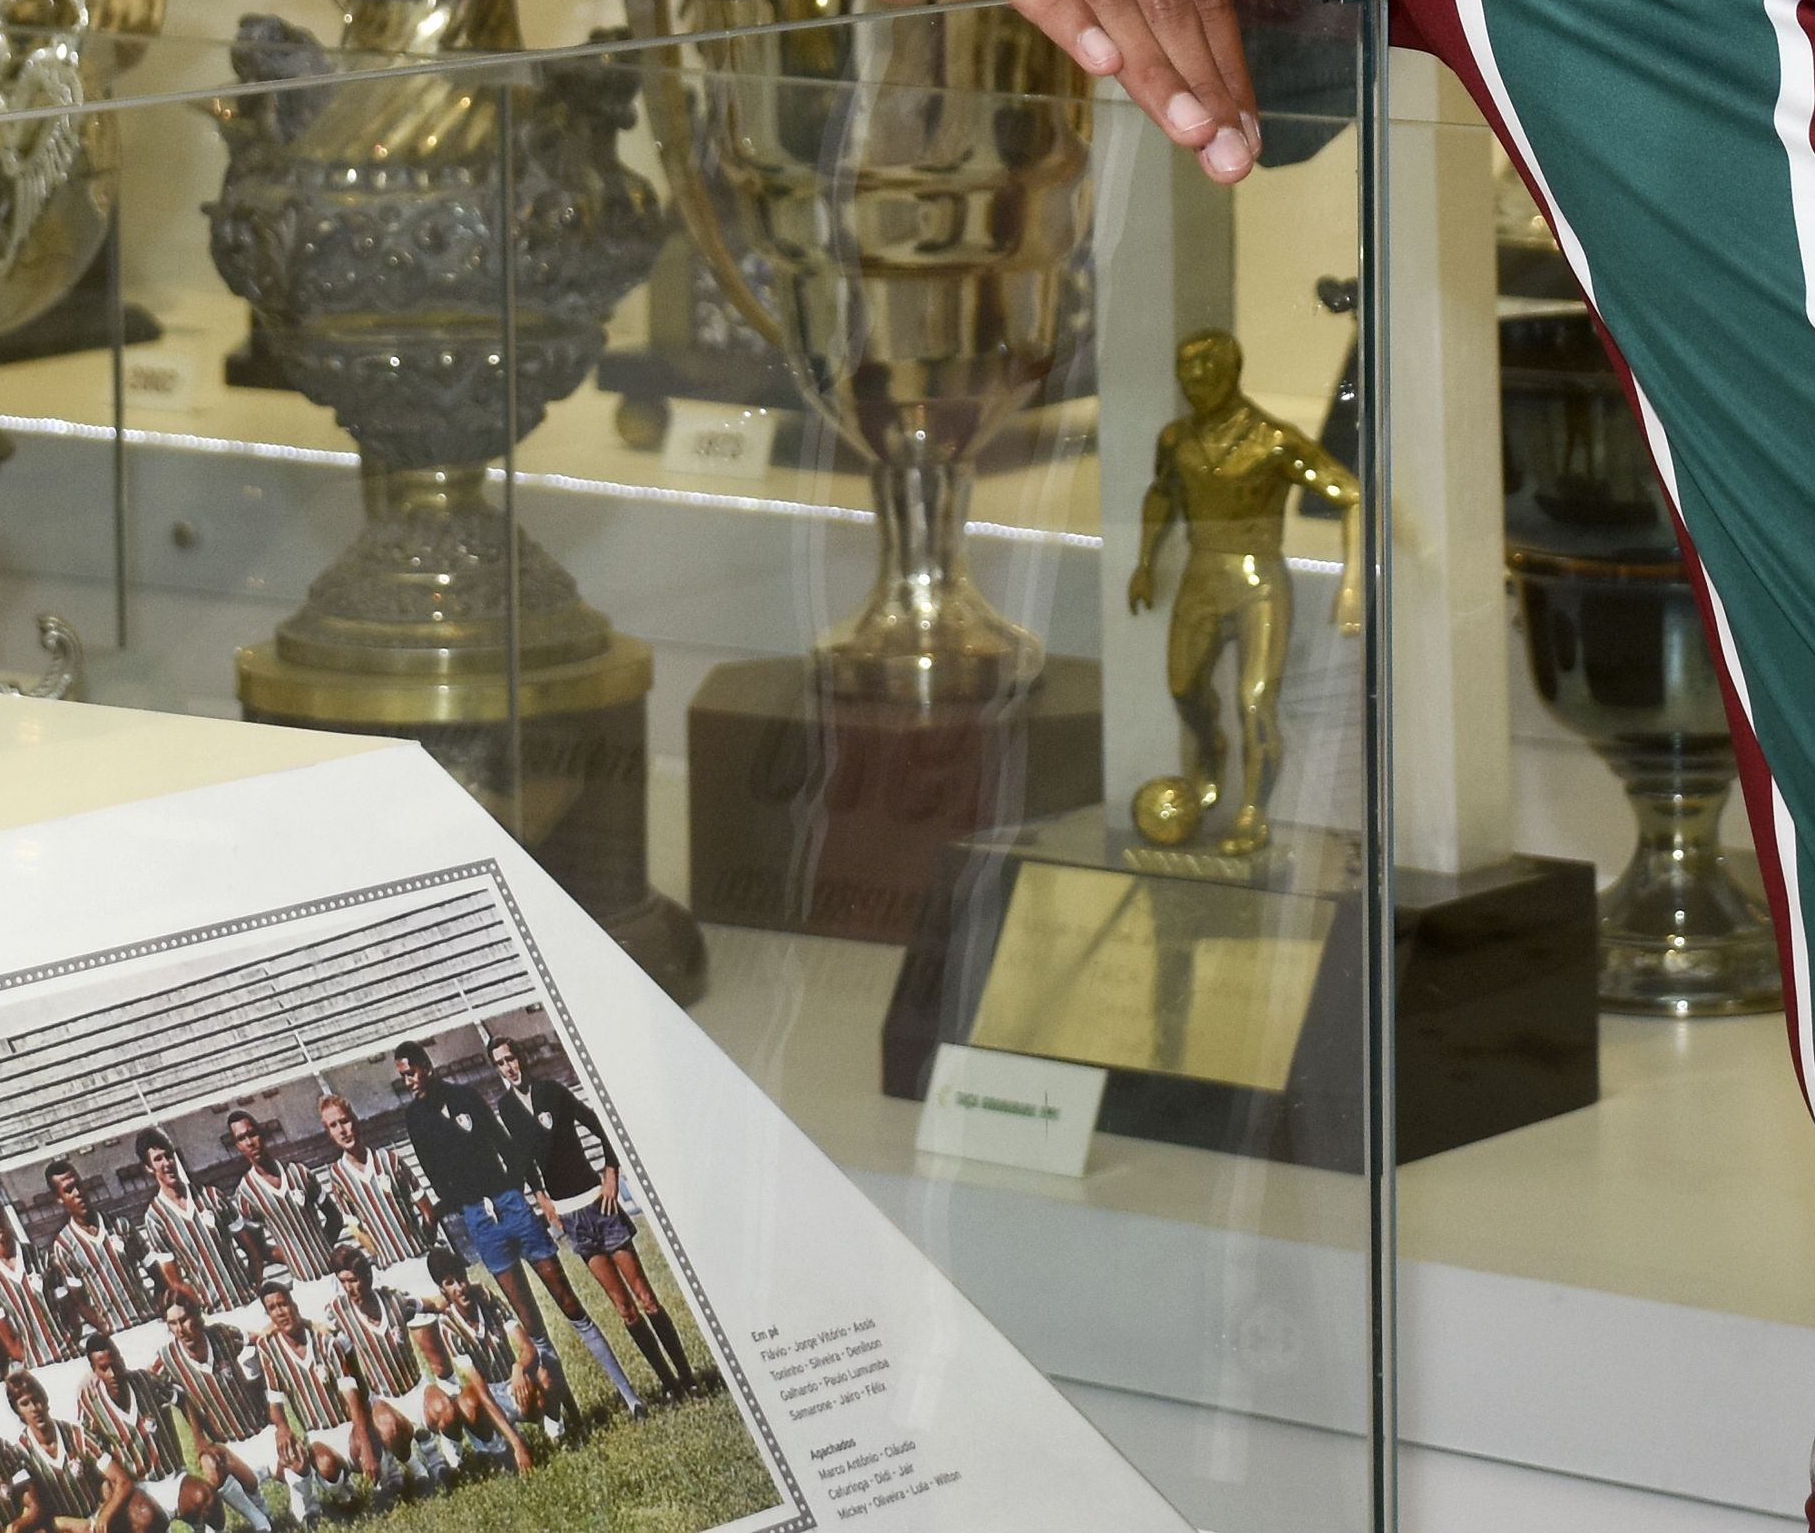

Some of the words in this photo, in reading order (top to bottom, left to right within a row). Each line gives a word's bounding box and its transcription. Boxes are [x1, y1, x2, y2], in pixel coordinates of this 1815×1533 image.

[751, 1331, 768, 1342] Em
[794, 1337, 818, 1352] Jorge
[853, 1318, 876, 1333] Assis
[770, 1363, 805, 1381] Toninho
[809, 1353, 842, 1369] Silveira
[846, 1339, 883, 1358] Denilson
[780, 1381, 819, 1401] Galhardo
[823, 1372, 849, 1387] Paulo
[847, 1358, 890, 1379] Lumumba
[789, 1399, 834, 1421] Samarone
[840, 1390, 861, 1405] Jairo
[865, 1381, 887, 1396] Félix
[810, 1438, 857, 1460] Agachados
[818, 1465, 846, 1480] Marco
[828, 1479, 870, 1500] Cafuringa
[874, 1470, 892, 1485] Didi
[898, 1462, 915, 1477] Jair
[837, 1502, 869, 1520] Mickey
[872, 1489, 906, 1508] Oliveira
[909, 1481, 930, 1495] Lula
